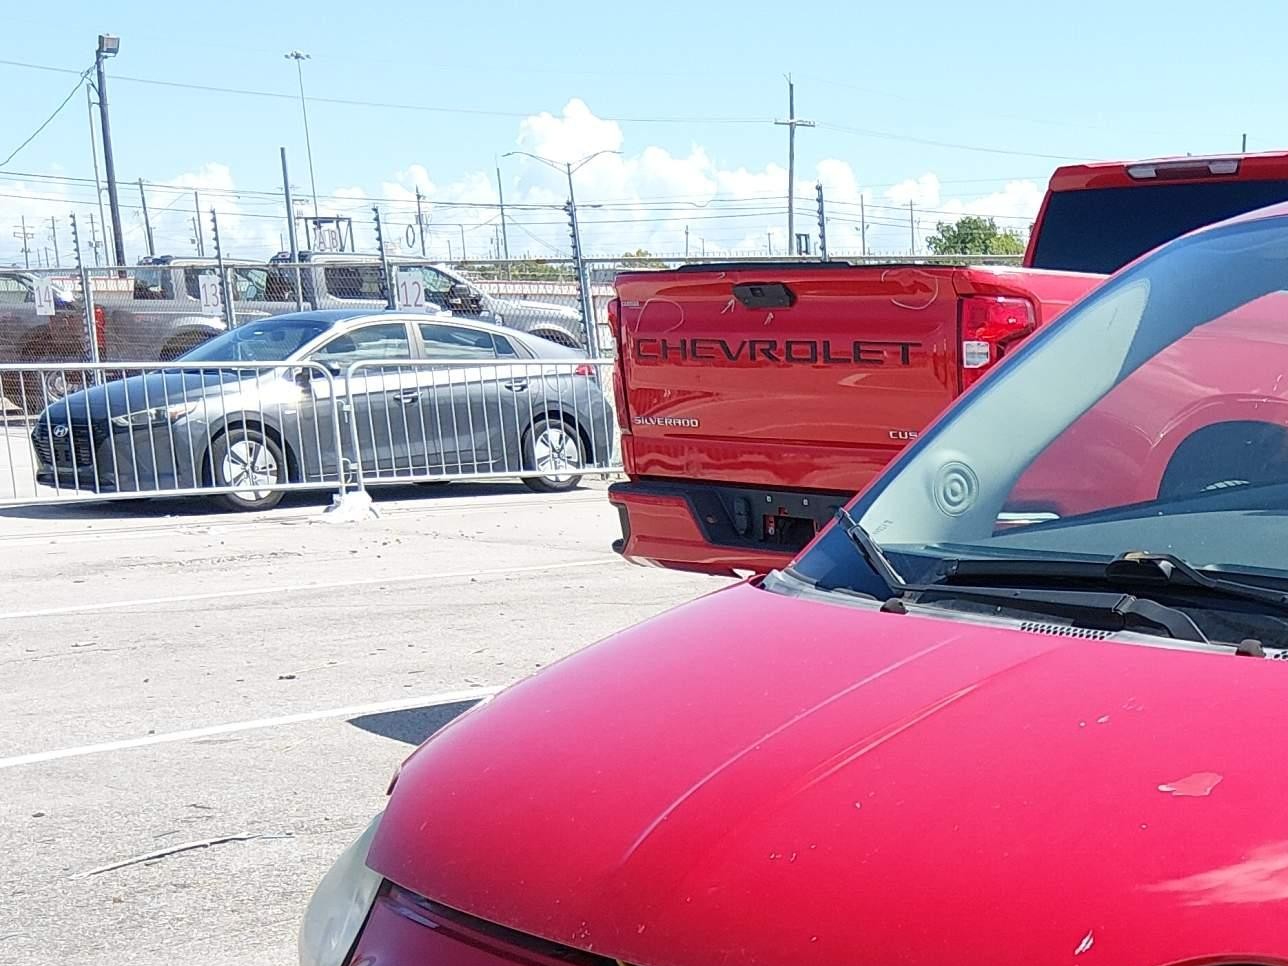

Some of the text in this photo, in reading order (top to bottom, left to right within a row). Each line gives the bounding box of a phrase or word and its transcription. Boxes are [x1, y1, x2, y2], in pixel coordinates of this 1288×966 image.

[36, 285, 52, 308] 14
[202, 283, 219, 308] 13
[400, 281, 424, 307] 12
[636, 338, 923, 365] CHEVROLET
[633, 416, 700, 428] SILVERADO
